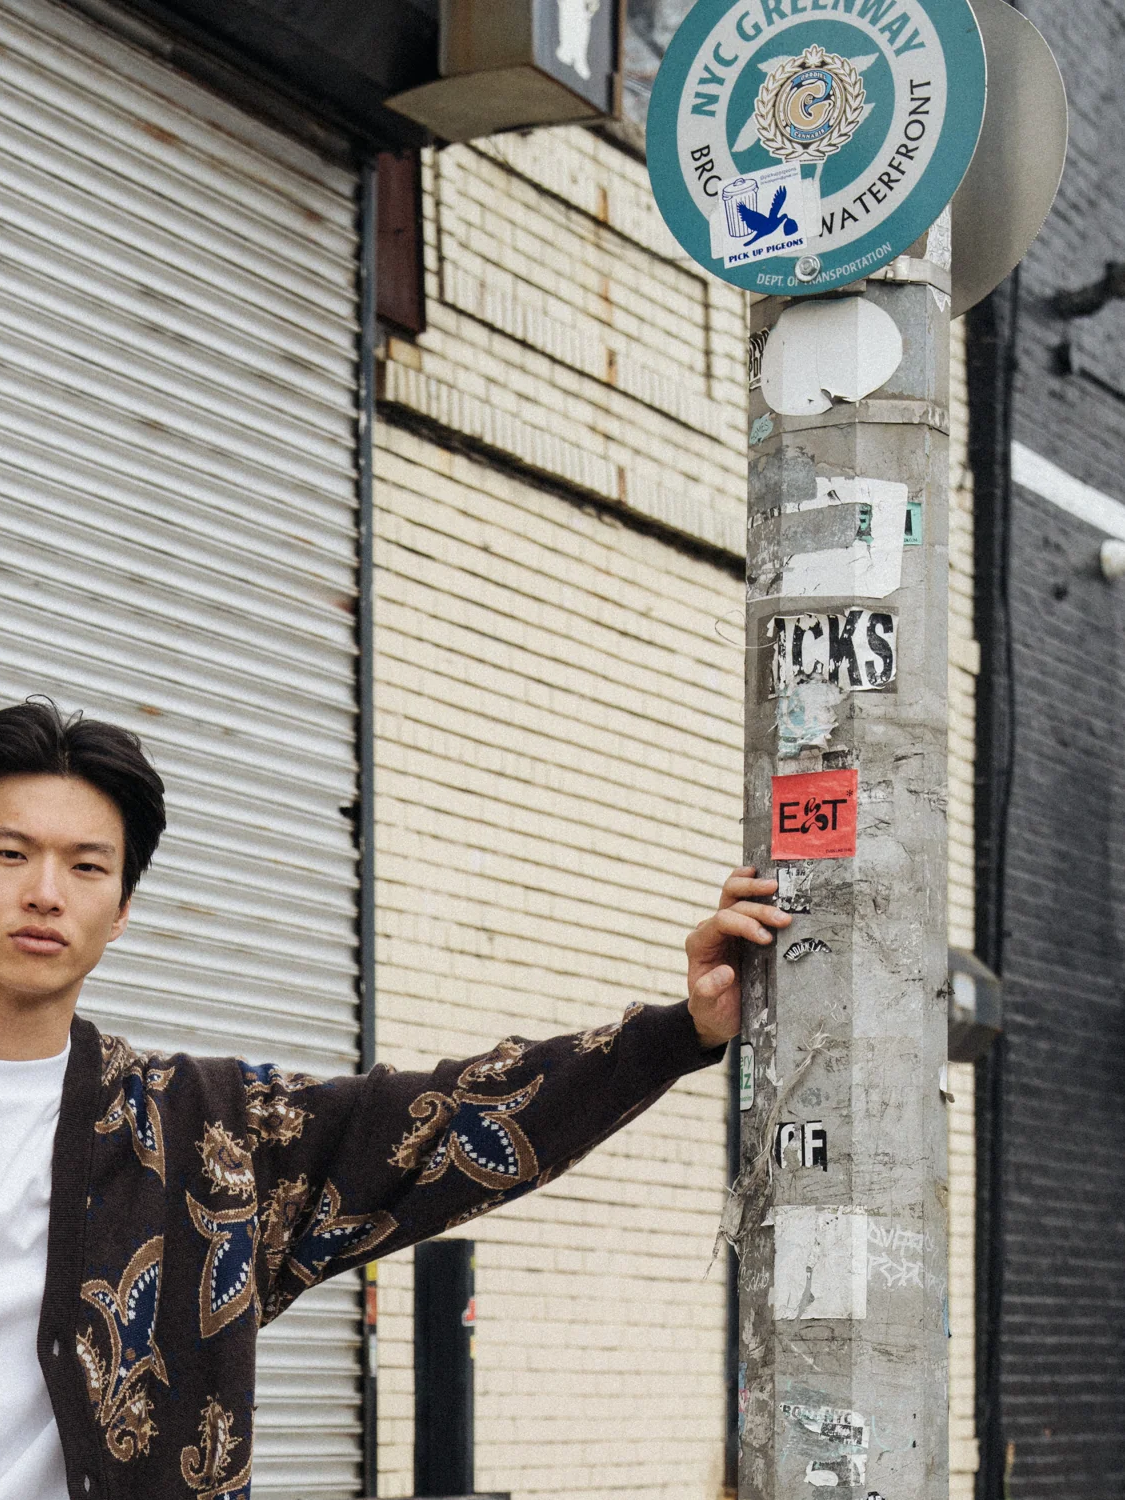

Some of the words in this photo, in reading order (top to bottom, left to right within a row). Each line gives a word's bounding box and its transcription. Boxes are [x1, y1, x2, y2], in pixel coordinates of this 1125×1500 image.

[690, 42, 739, 118] NYC
[728, 251, 750, 263] PICK
[752, 248, 764, 257] UP
[766, 237, 804, 253] PIGEONS
[756, 272, 785, 288] DEPT.
[802, 241, 893, 286] RANSPORTATION
